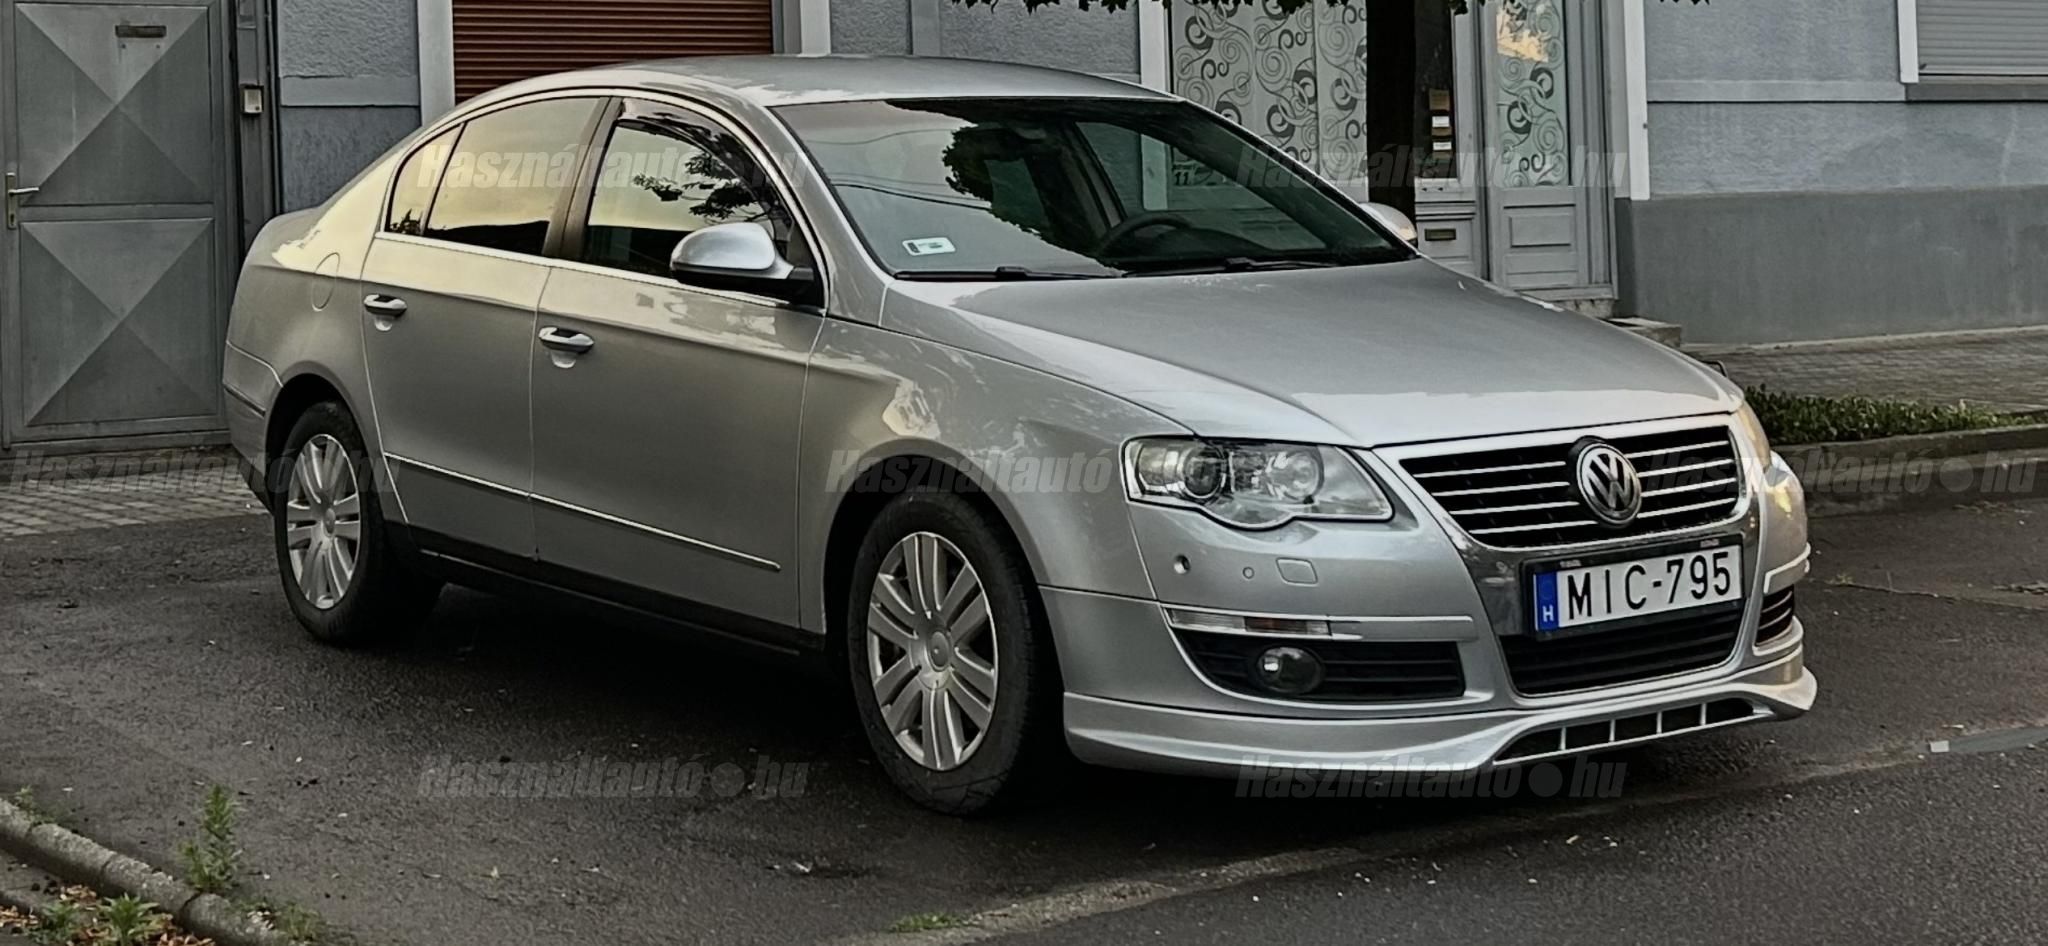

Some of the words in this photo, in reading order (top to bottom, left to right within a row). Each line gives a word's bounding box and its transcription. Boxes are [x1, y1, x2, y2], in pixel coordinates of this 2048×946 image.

[1581, 444, 1639, 522] VW
[1541, 604, 1555, 622] H
[1567, 551, 1732, 620] MIC-795
